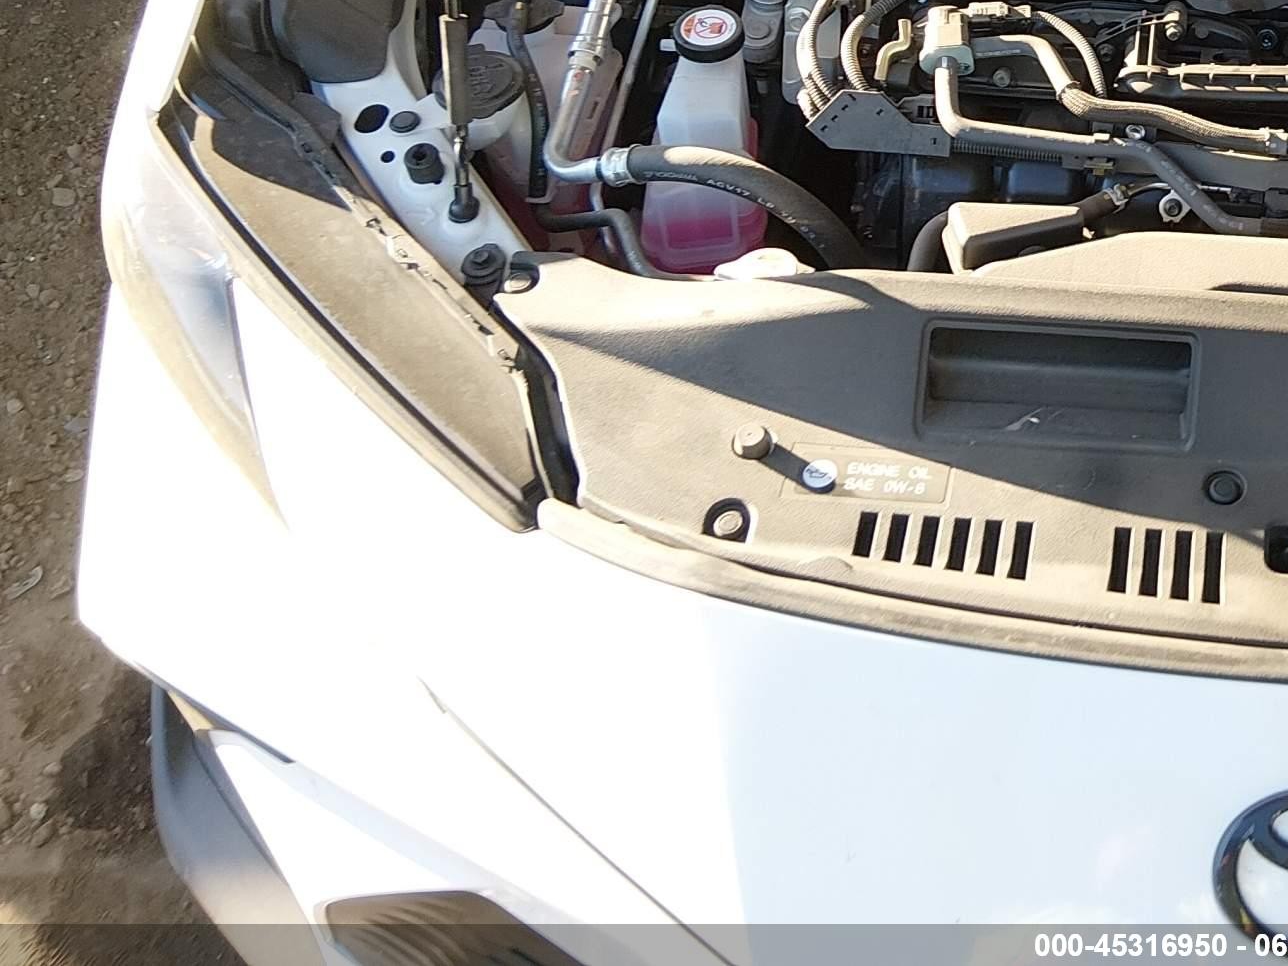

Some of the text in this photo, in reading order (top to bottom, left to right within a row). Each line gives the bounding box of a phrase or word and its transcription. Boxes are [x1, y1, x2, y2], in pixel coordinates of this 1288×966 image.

[847, 462, 932, 480] ENGINE OIL
[843, 477, 874, 491] SAE
